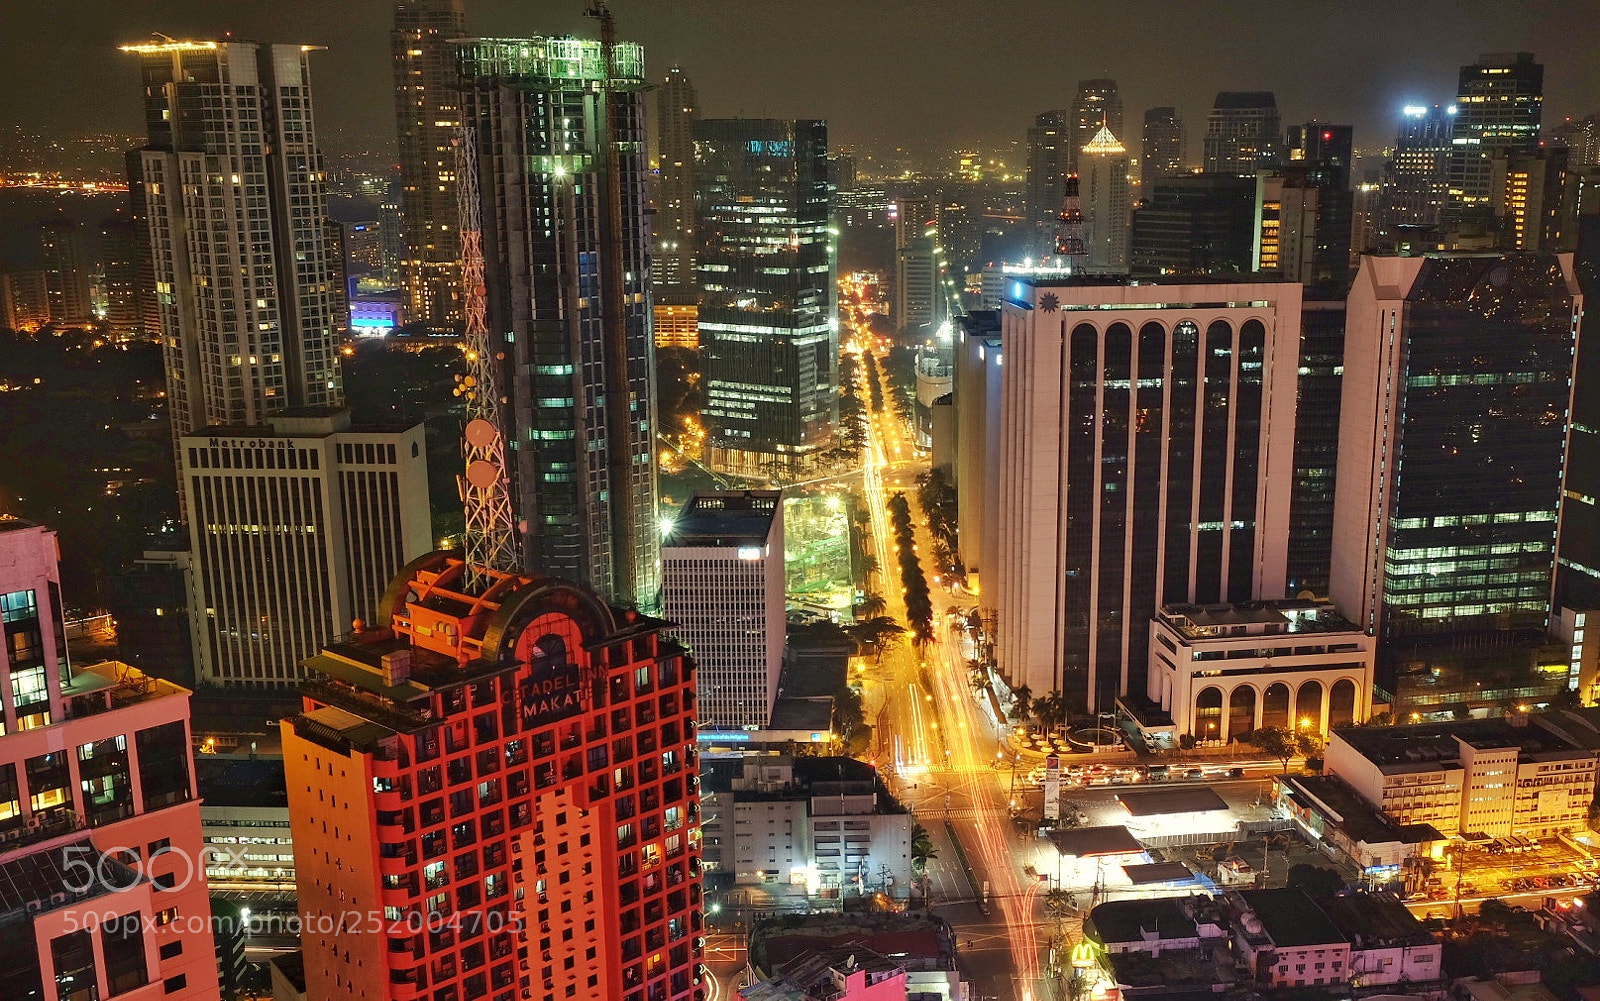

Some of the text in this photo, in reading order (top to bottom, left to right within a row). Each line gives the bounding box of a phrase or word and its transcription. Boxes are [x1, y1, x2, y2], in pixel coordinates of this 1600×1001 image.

[210, 438, 294, 448] Metrobank
[502, 675, 575, 704] CITADEL
[523, 689, 588, 718] MAKATI
